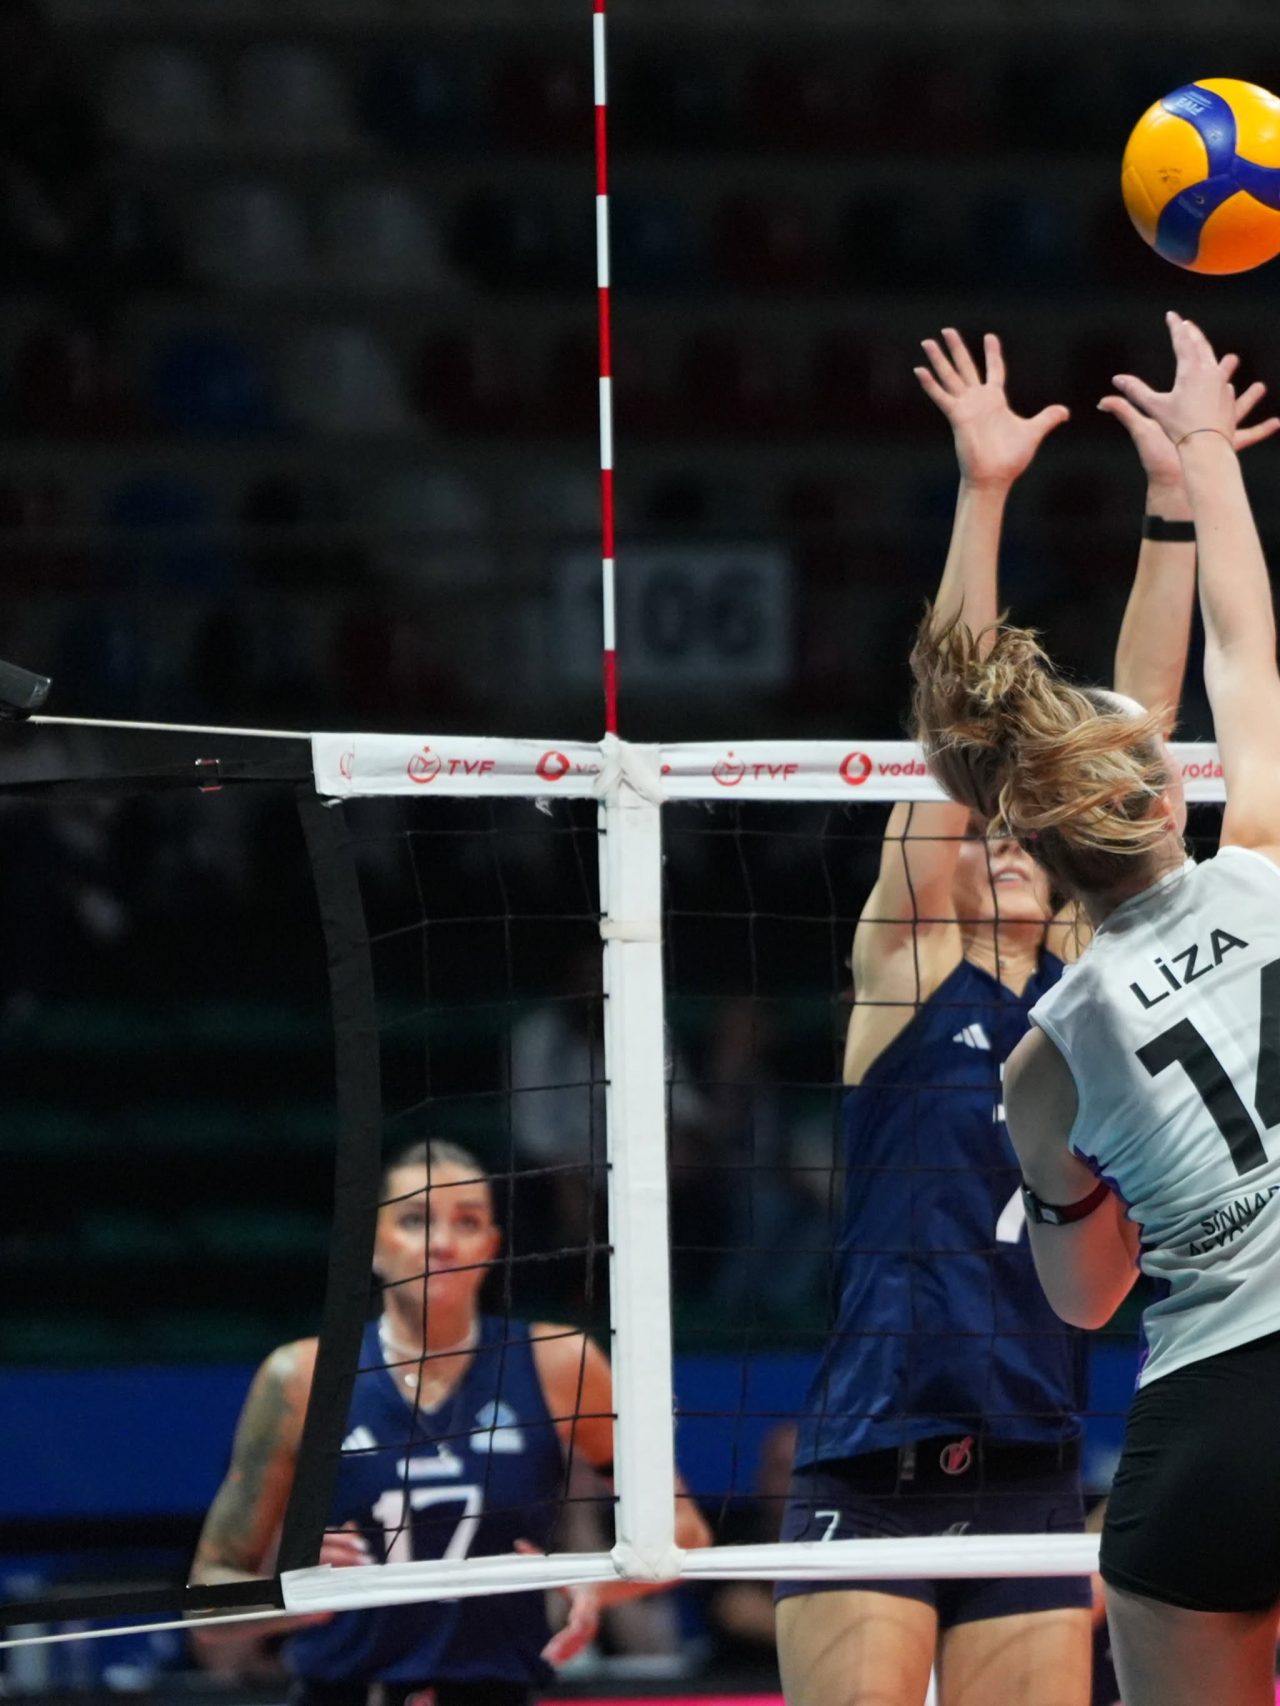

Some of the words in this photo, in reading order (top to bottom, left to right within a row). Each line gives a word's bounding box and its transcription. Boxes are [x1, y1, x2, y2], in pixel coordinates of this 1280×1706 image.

[447, 759, 495, 776] TVF
[751, 763, 798, 780] TVF
[878, 758, 926, 777] voda
[1129, 928, 1250, 1010] LİZA
[372, 1483, 483, 1563] 17
[814, 1510, 841, 1542] 7
